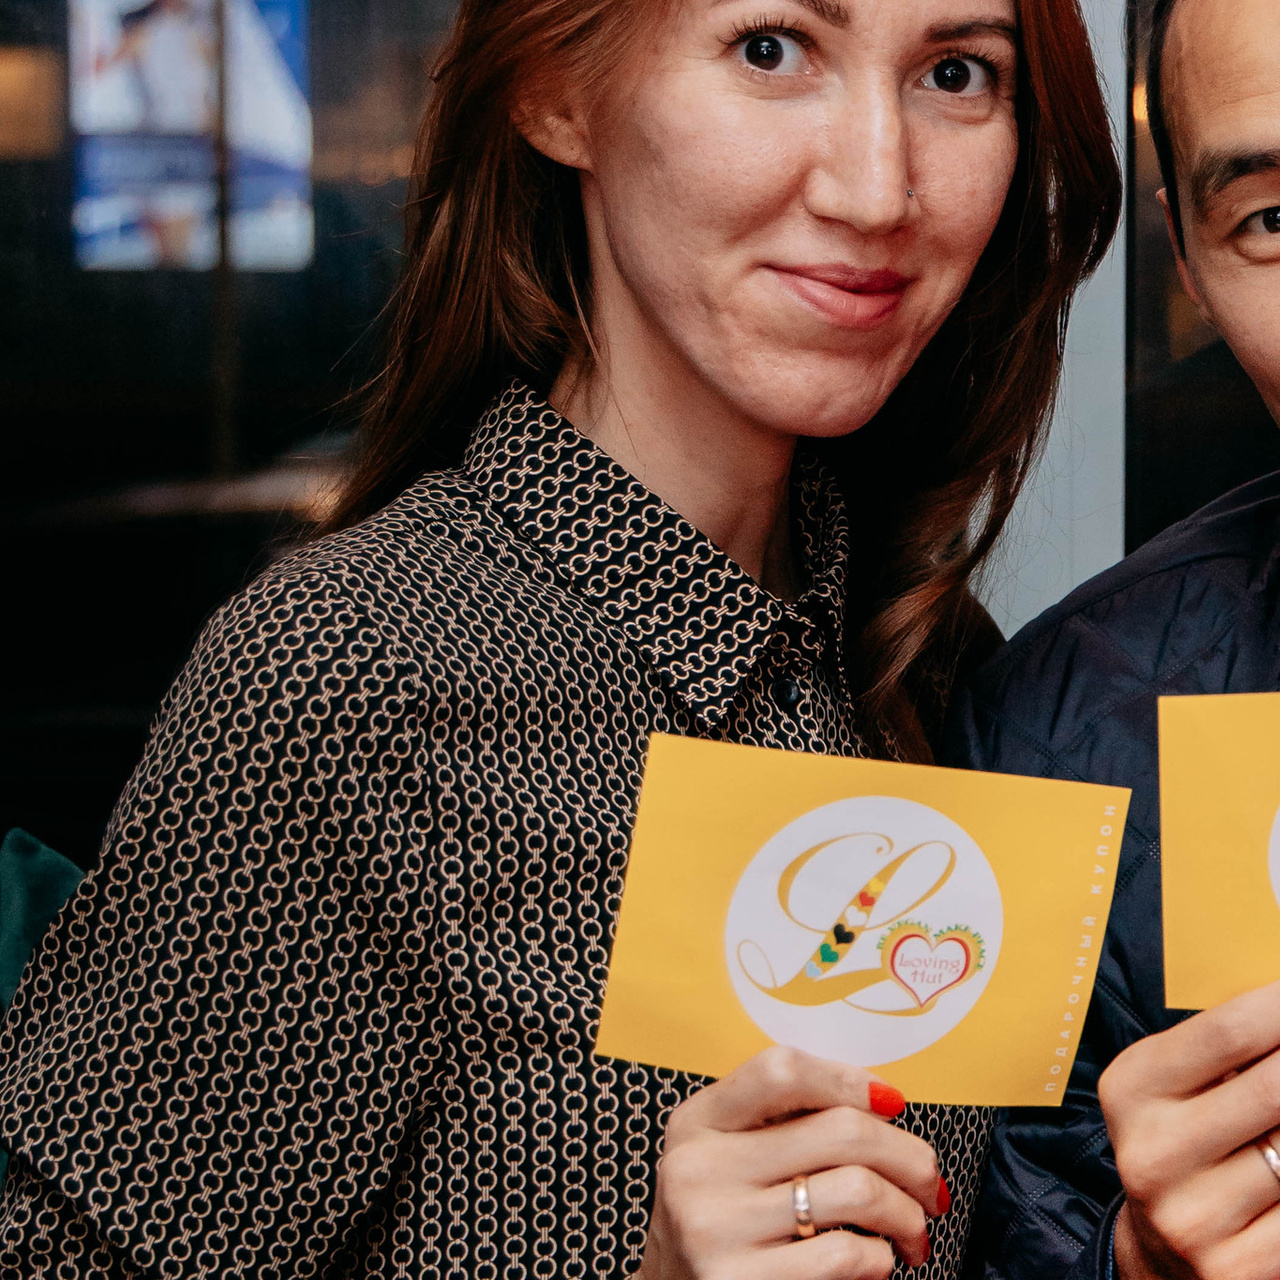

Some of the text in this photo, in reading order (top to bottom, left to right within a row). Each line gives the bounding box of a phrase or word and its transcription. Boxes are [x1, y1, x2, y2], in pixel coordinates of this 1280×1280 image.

[1044, 804, 1117, 1093] ПОДАРОЧНЫЙ КУПОН
[898, 953, 961, 974] Loving
[911, 970, 943, 985] Hut
